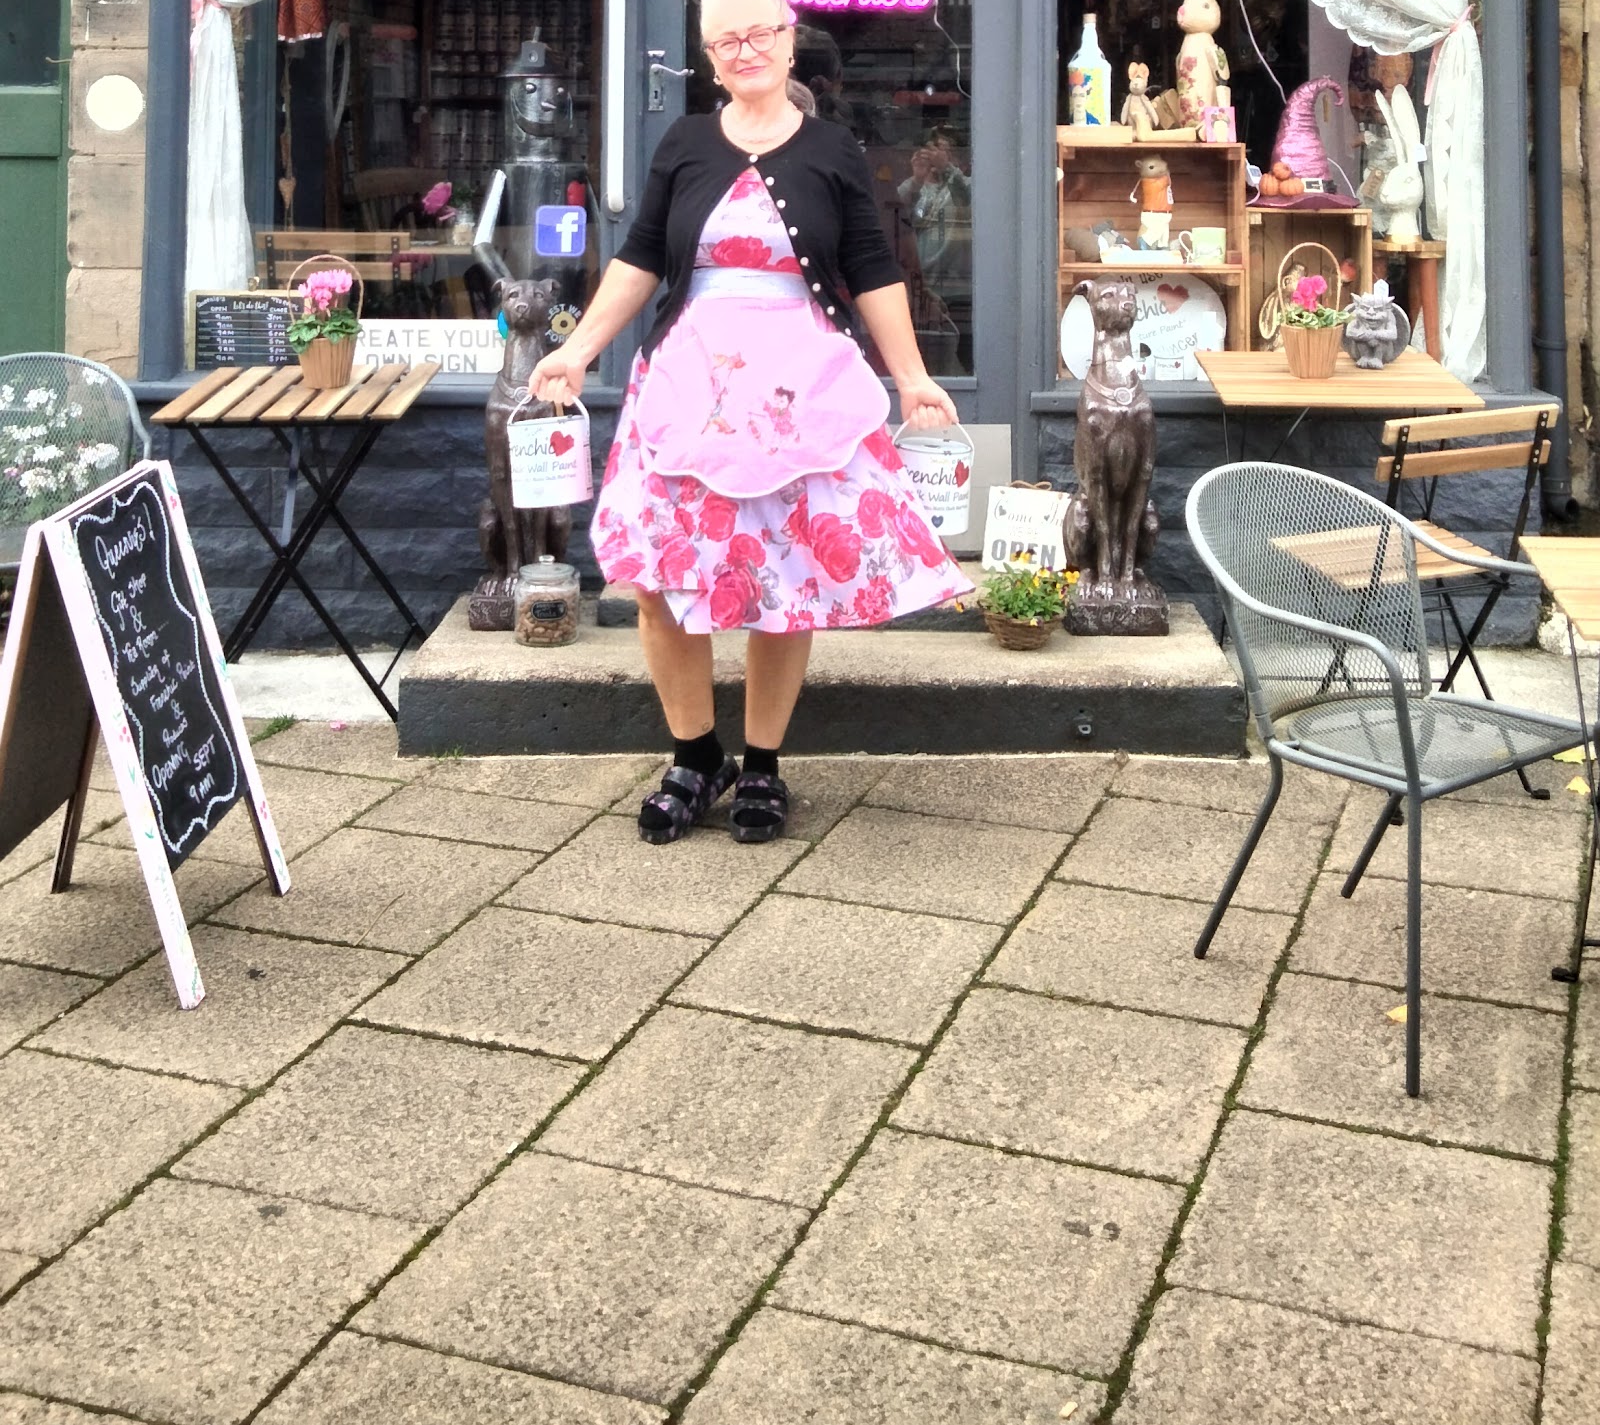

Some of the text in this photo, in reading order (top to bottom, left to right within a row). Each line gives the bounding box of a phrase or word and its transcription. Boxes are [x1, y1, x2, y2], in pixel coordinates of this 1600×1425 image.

[1135, 296, 1169, 322] chic
[356, 329, 506, 349] REATE YOUR
[366, 353, 478, 373] OWN SIGN
[508, 437, 557, 457] renchic
[903, 464, 959, 486] renchic
[991, 538, 1057, 567] OPEN
[192, 733, 216, 772] SEPT
